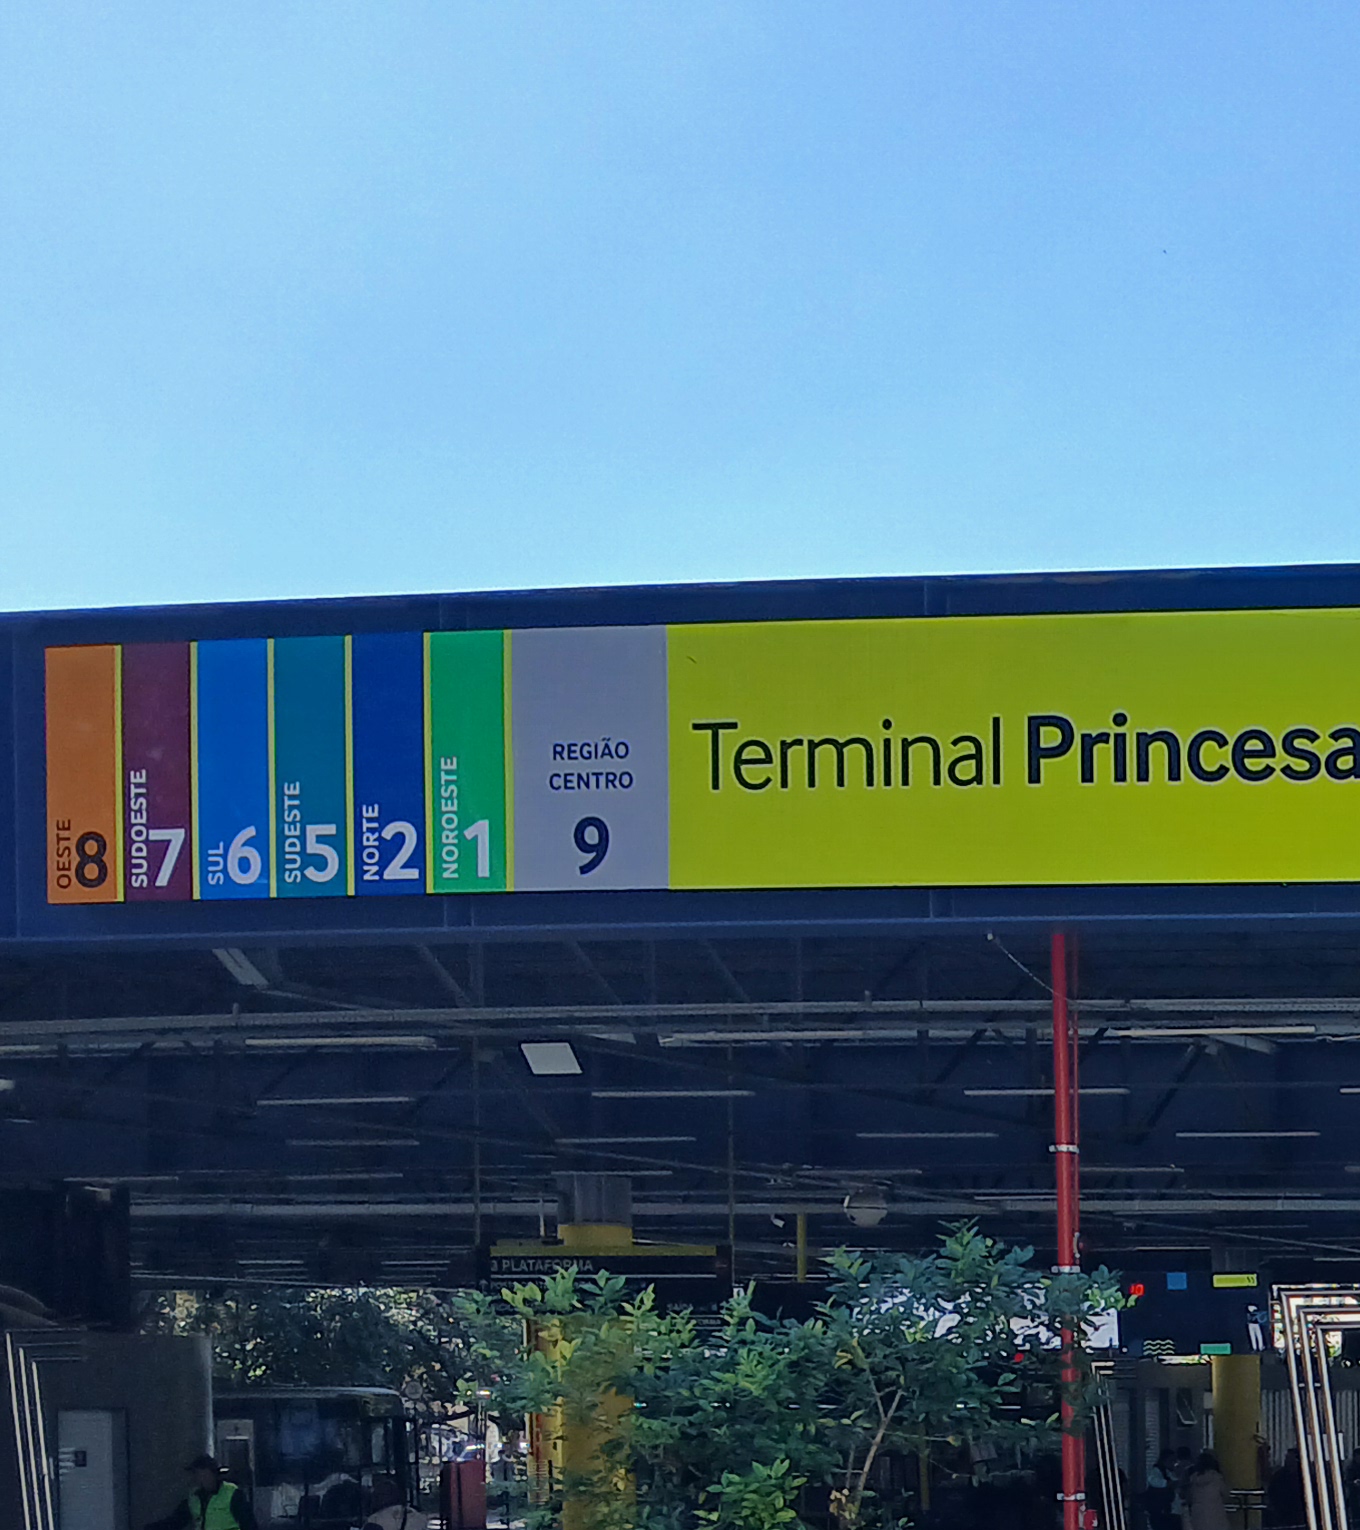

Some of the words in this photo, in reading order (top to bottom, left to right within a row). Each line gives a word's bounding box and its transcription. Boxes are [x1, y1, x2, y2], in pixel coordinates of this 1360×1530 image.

[552, 737, 630, 761] REGIÃO
[692, 717, 1001, 792] Terminal
[549, 771, 634, 791] CENTRO
[130, 769, 148, 888] SUDOESTE
[284, 781, 301, 883] SUDESTE
[362, 804, 379, 881] NORTE
[440, 756, 459, 879] NOROESTE
[573, 816, 610, 876] 9
[56, 819, 71, 889] OESTE
[75, 831, 108, 888] 8
[149, 828, 185, 887] 7
[208, 841, 224, 885] SUL
[227, 826, 261, 885] 6
[303, 824, 339, 883] 5
[381, 821, 419, 880] 2
[463, 819, 490, 878] 1
